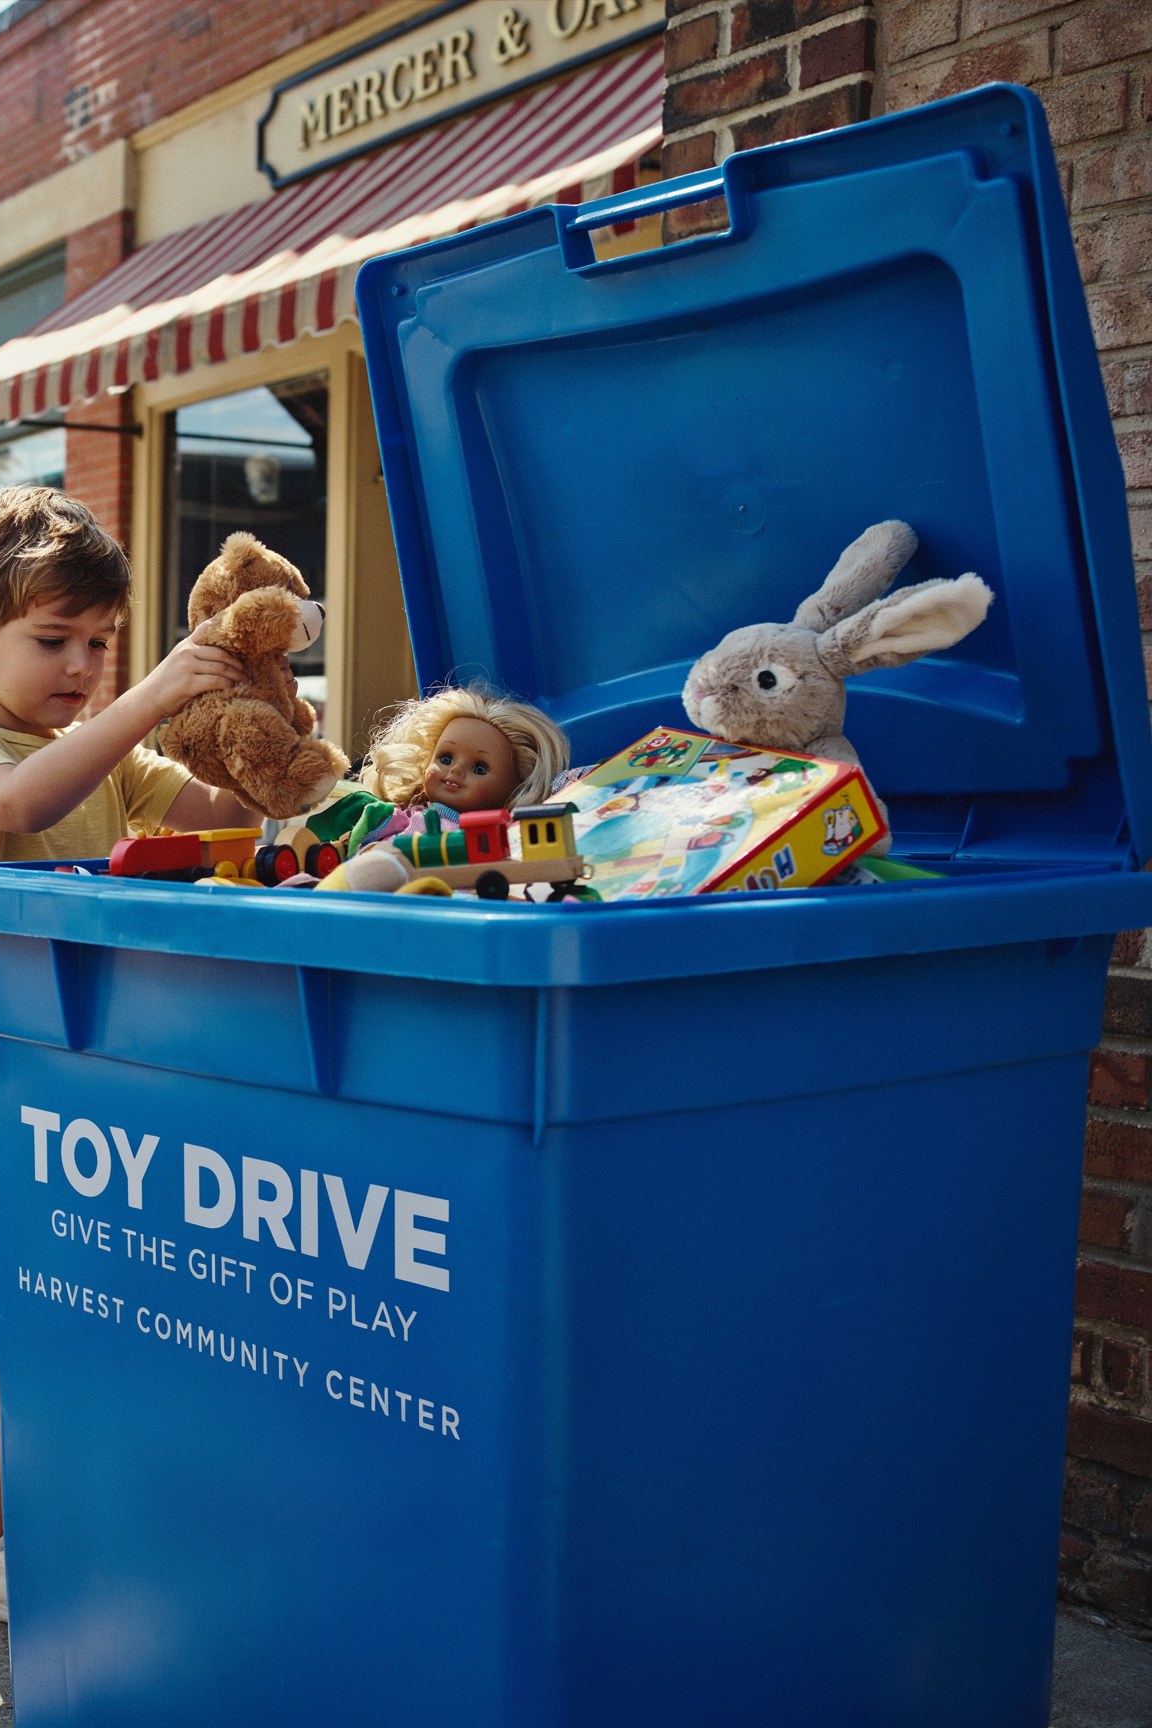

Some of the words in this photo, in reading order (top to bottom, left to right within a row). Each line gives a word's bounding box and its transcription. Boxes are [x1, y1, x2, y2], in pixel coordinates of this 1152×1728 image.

[299, 29, 476, 147] MERCER
[492, 8, 531, 64] &
[20, 1105, 161, 1210] TOY
[183, 1142, 450, 1293] DRIVE
[51, 1209, 111, 1252] GIVE
[121, 1228, 177, 1272] THE
[188, 1248, 257, 1294] GIFT
[269, 1272, 314, 1309] OF
[328, 1287, 418, 1342] PLAY
[19, 1266, 124, 1324] HARVEST
[136, 1307, 310, 1388] COMMUNITY
[326, 1370, 460, 1440] CENTER
